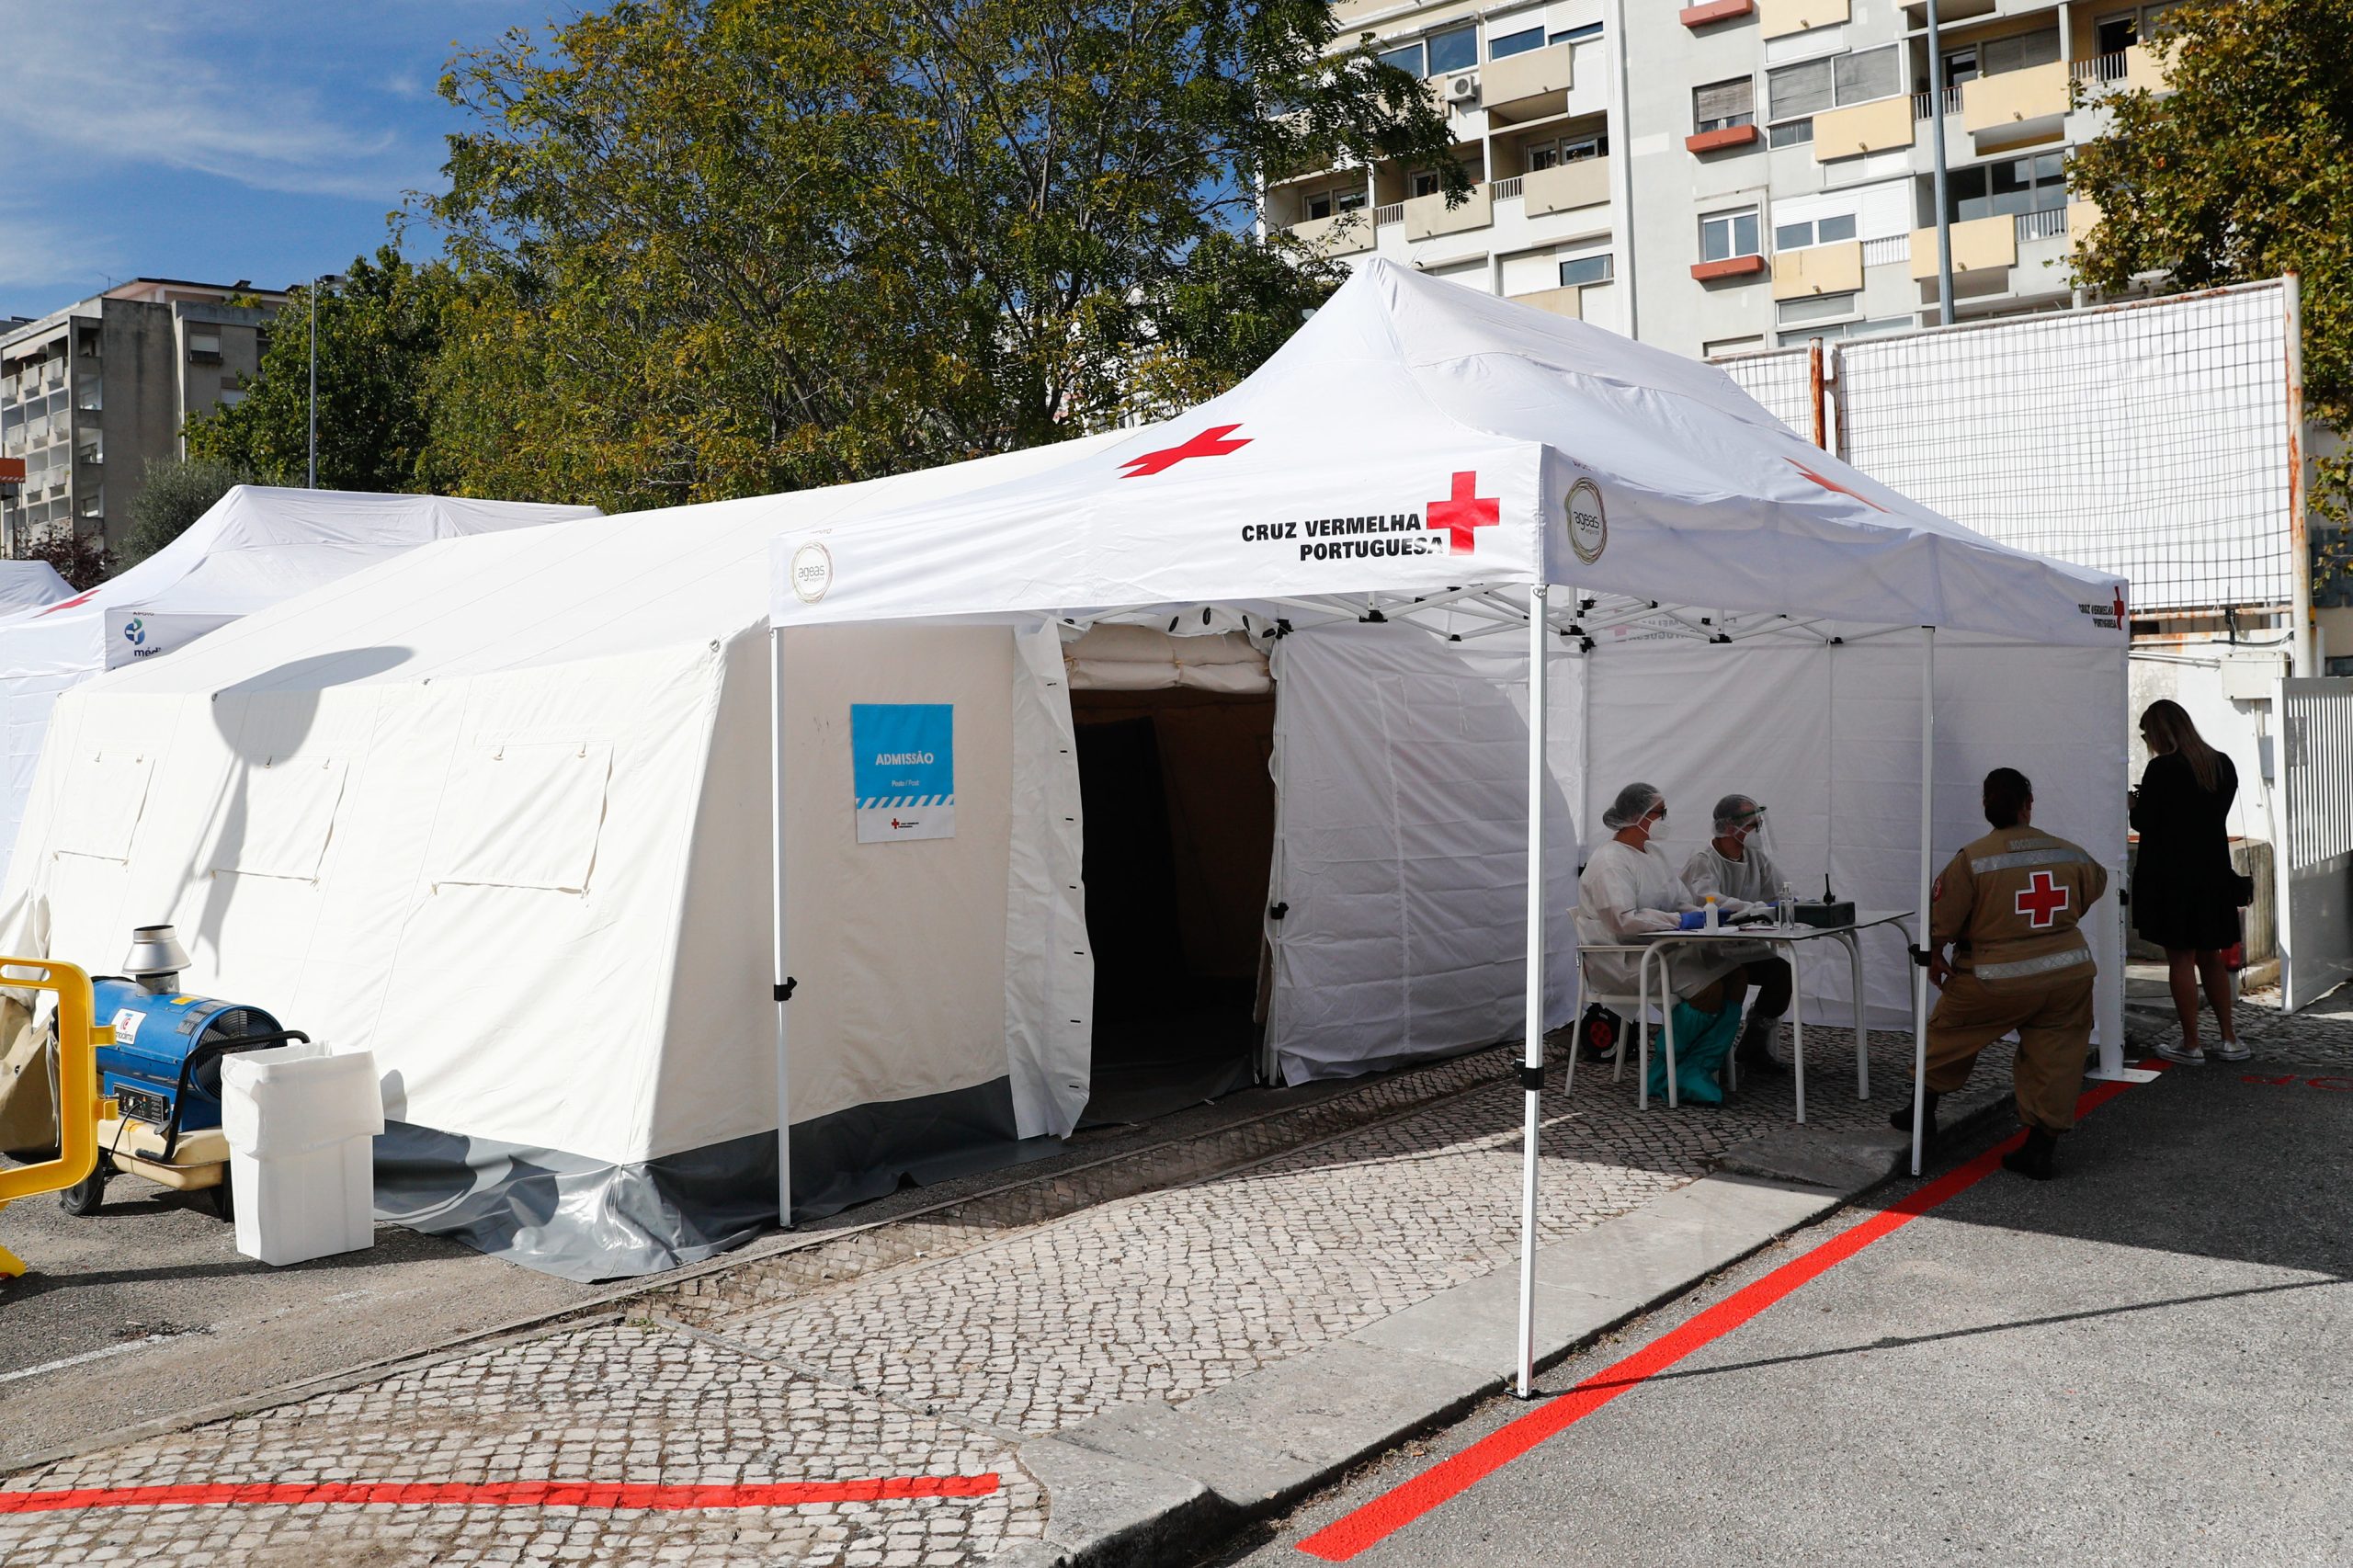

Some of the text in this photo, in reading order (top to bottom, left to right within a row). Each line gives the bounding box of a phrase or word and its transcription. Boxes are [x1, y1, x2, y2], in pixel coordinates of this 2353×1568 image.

[1242, 514, 1422, 542] CRUZ VERMELHA
[1573, 511, 1599, 530] ageas
[1301, 537, 1443, 561] PORTUGUESA
[798, 565, 825, 581] ageas
[875, 751, 934, 766] ADMISSÃO
